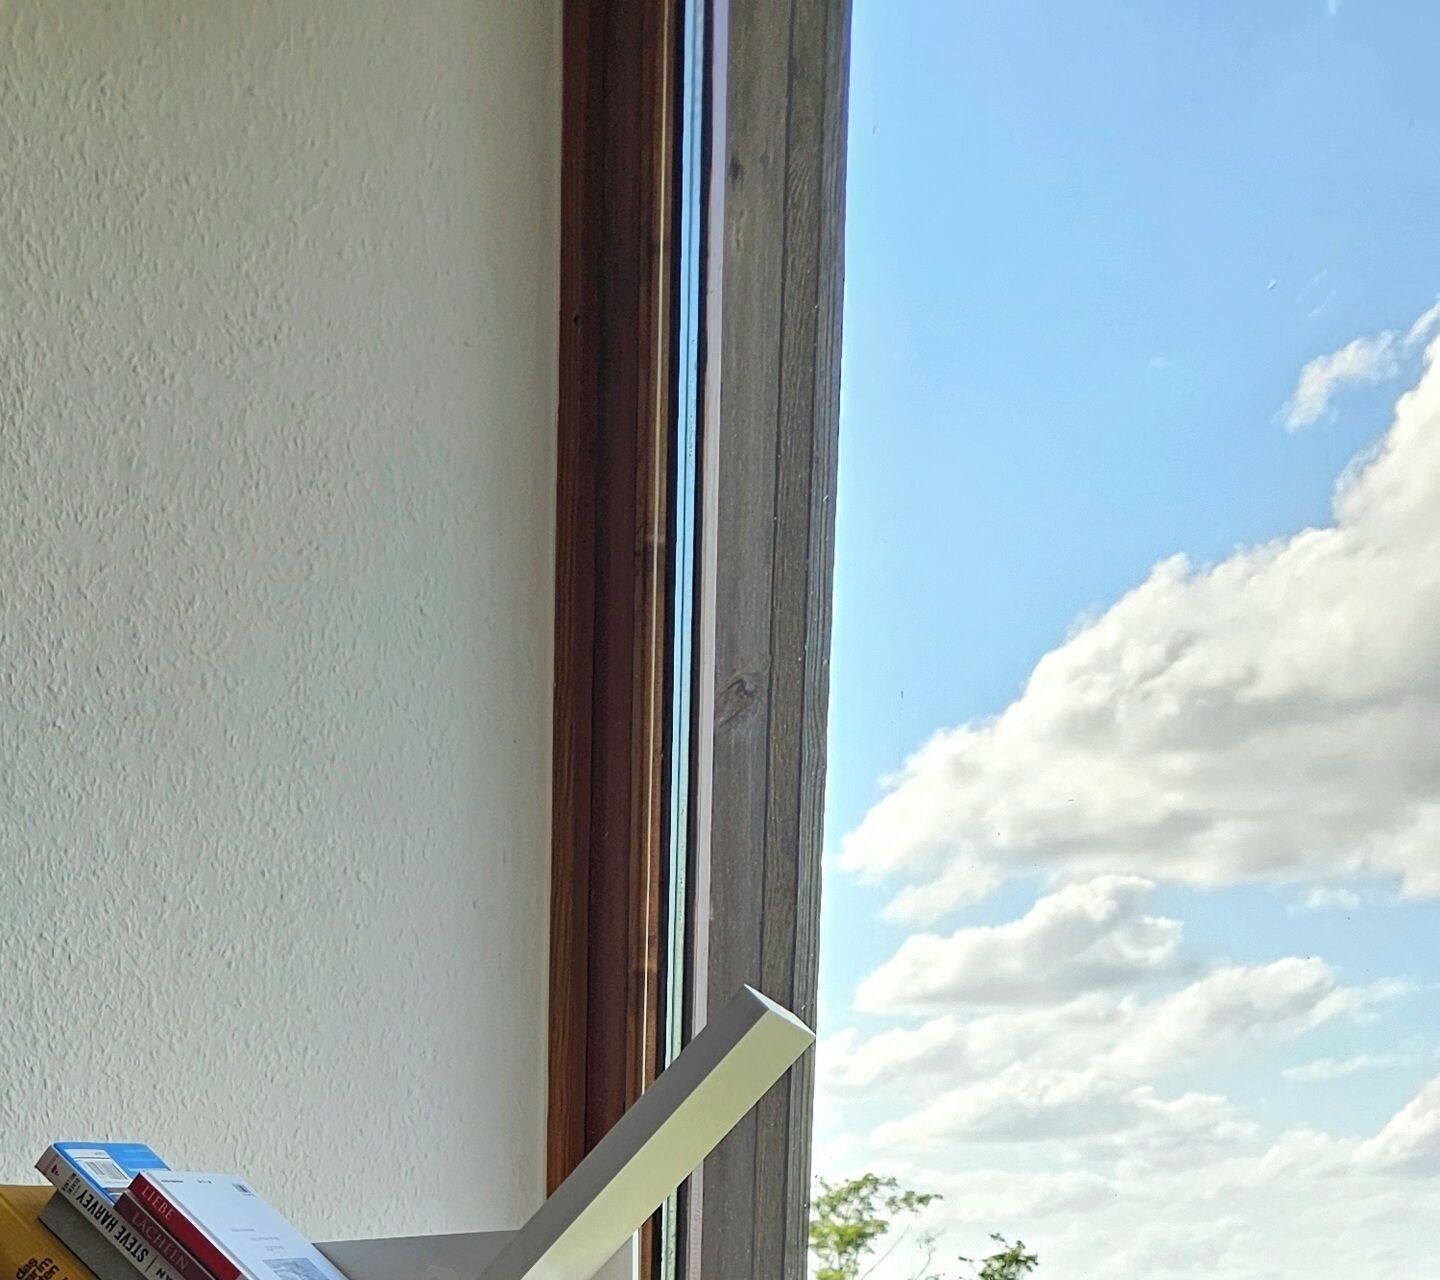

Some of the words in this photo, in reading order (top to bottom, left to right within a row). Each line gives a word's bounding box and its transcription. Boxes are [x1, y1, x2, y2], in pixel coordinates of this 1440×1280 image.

[73, 1186, 120, 1234] HARVEY
[139, 1183, 178, 1222] LIEBE
[110, 1223, 151, 1264] STEVE
